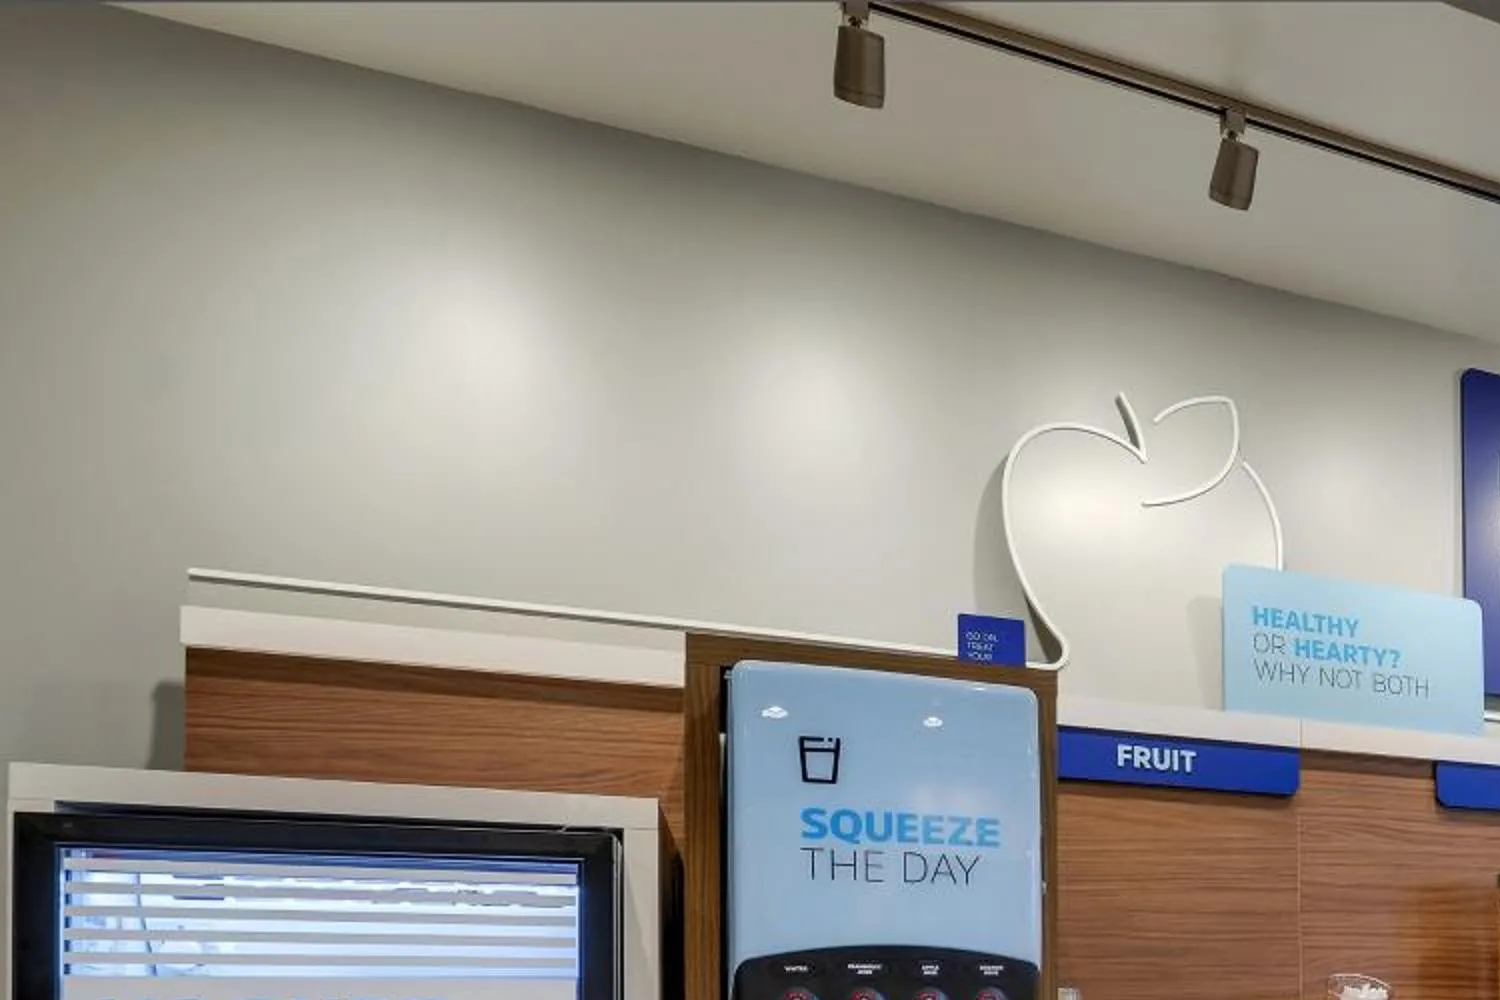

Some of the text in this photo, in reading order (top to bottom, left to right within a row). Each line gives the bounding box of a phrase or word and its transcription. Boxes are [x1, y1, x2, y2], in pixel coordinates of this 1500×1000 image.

[1252, 605, 1359, 638] HEALTHY
[1253, 632, 1402, 669] OR HEARTY?
[1253, 658, 1429, 698] WHY NOT BOTH
[1117, 743, 1197, 773] FRUIT
[800, 807, 1001, 848] SQUEEZE
[801, 847, 980, 886] THE DAY
